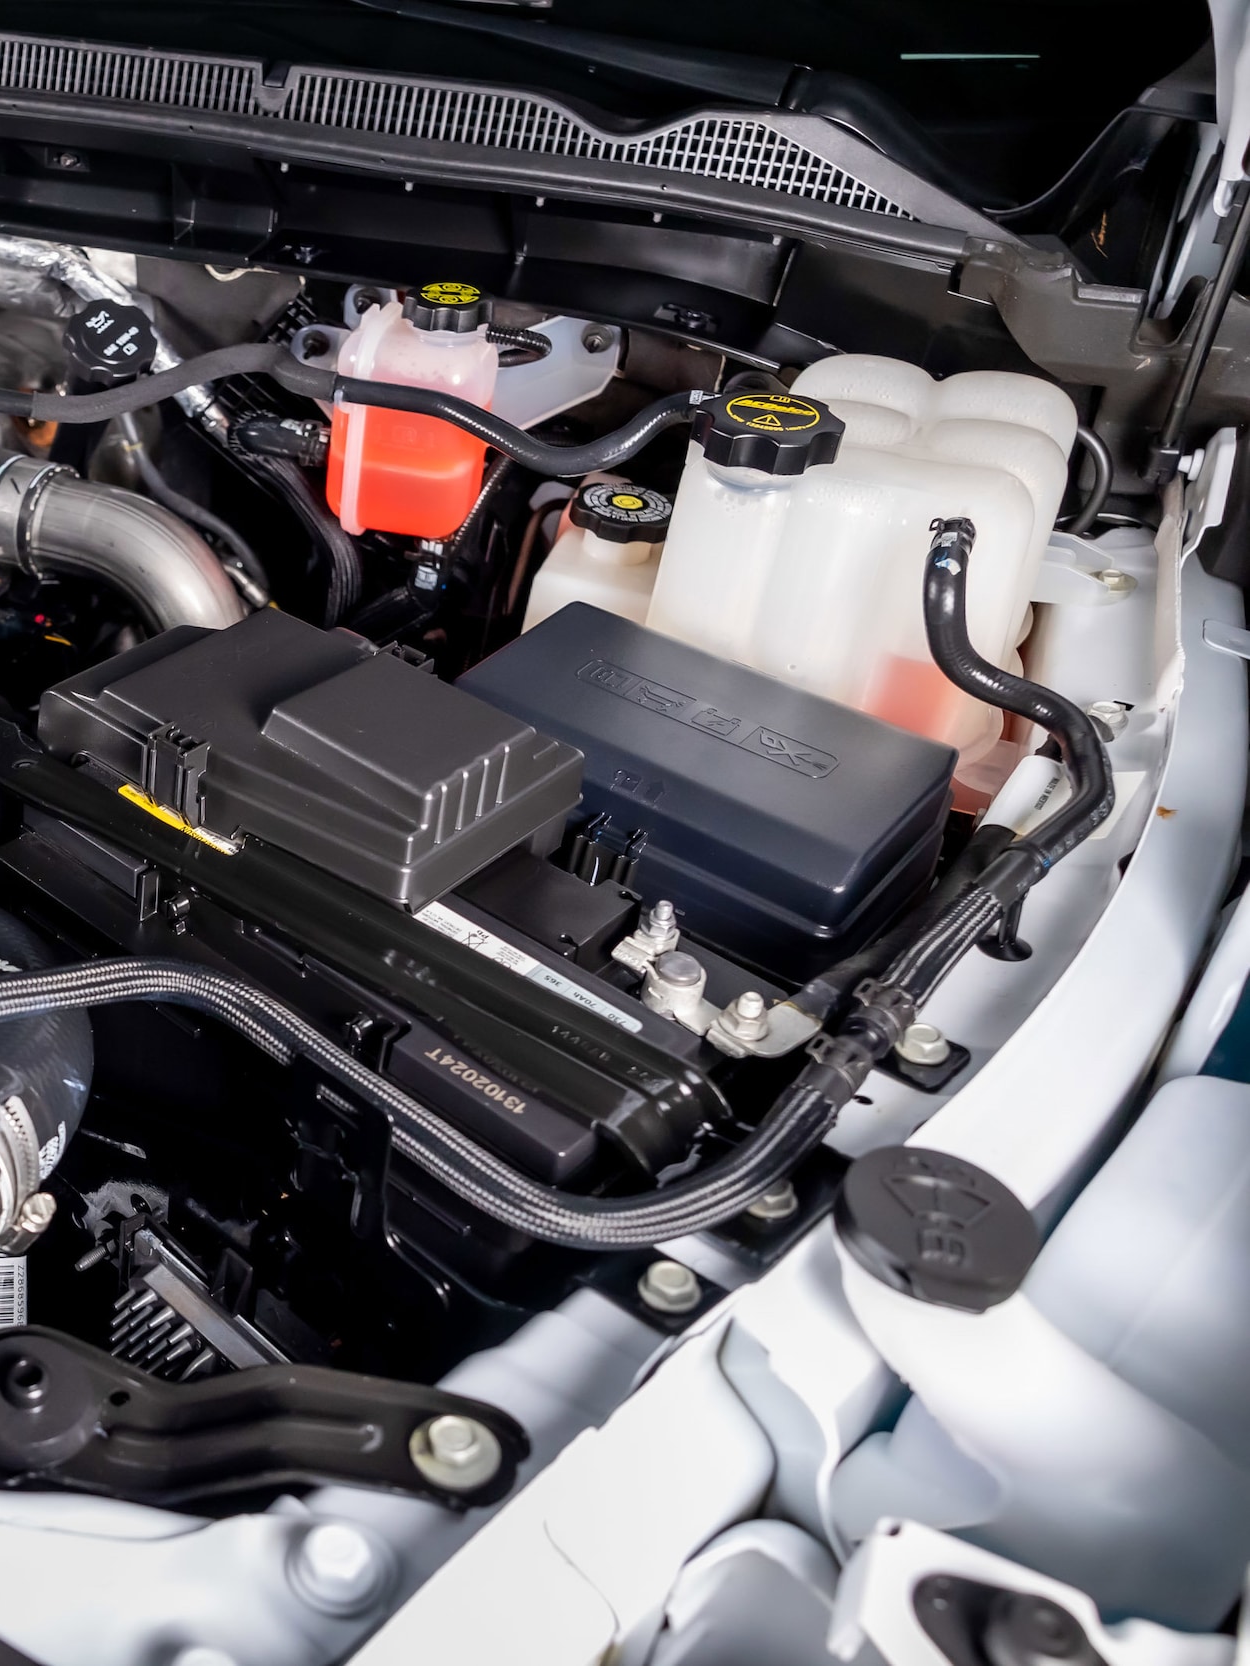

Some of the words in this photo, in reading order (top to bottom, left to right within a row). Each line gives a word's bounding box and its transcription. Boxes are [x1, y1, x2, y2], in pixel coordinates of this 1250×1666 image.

[733, 399, 816, 416] ACDelco
[476, 929, 490, 939] Pb
[544, 974, 563, 987] 365
[574, 991, 598, 1009] 70Ah
[424, 1048, 527, 1115] 13102024T
